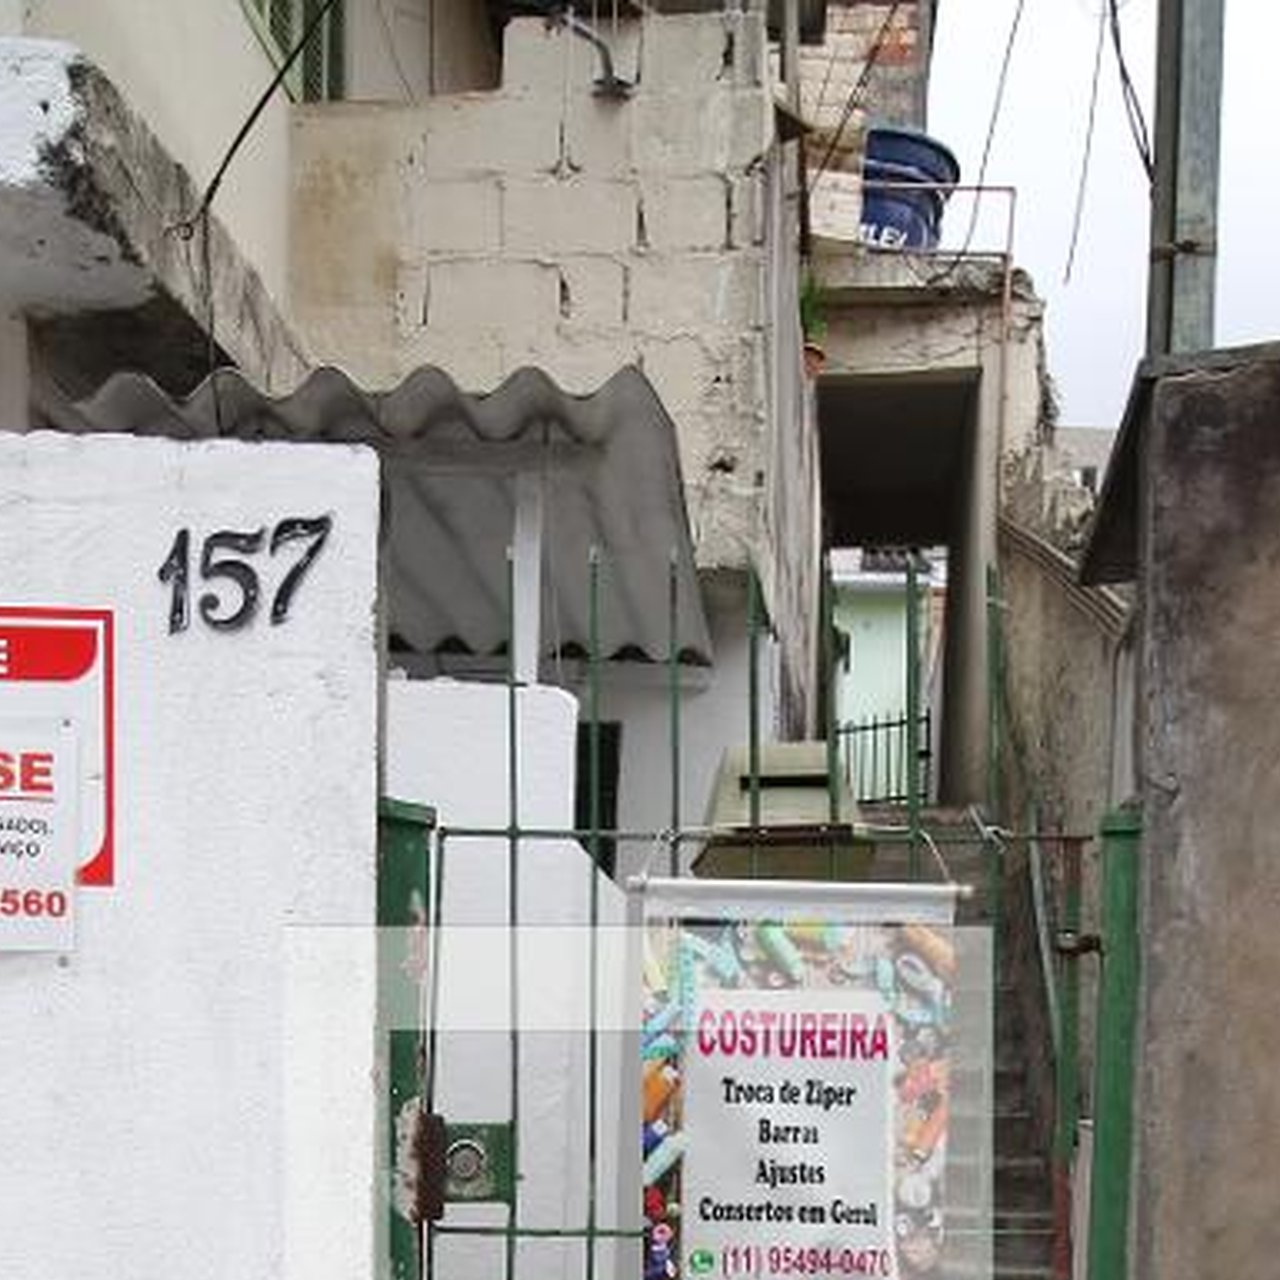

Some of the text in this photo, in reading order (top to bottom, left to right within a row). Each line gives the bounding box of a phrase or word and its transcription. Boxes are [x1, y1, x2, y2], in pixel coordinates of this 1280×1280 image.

[158, 516, 333, 635] 157
[698, 1010, 889, 1060] COSTUREIRA
[723, 1077, 774, 1104] Troca
[780, 1079, 800, 1104] de
[755, 1159, 825, 1188] Ajustes
[699, 1197, 793, 1222] Consertos
[799, 1203, 826, 1224] em
[723, 1244, 762, 1278] (11)
